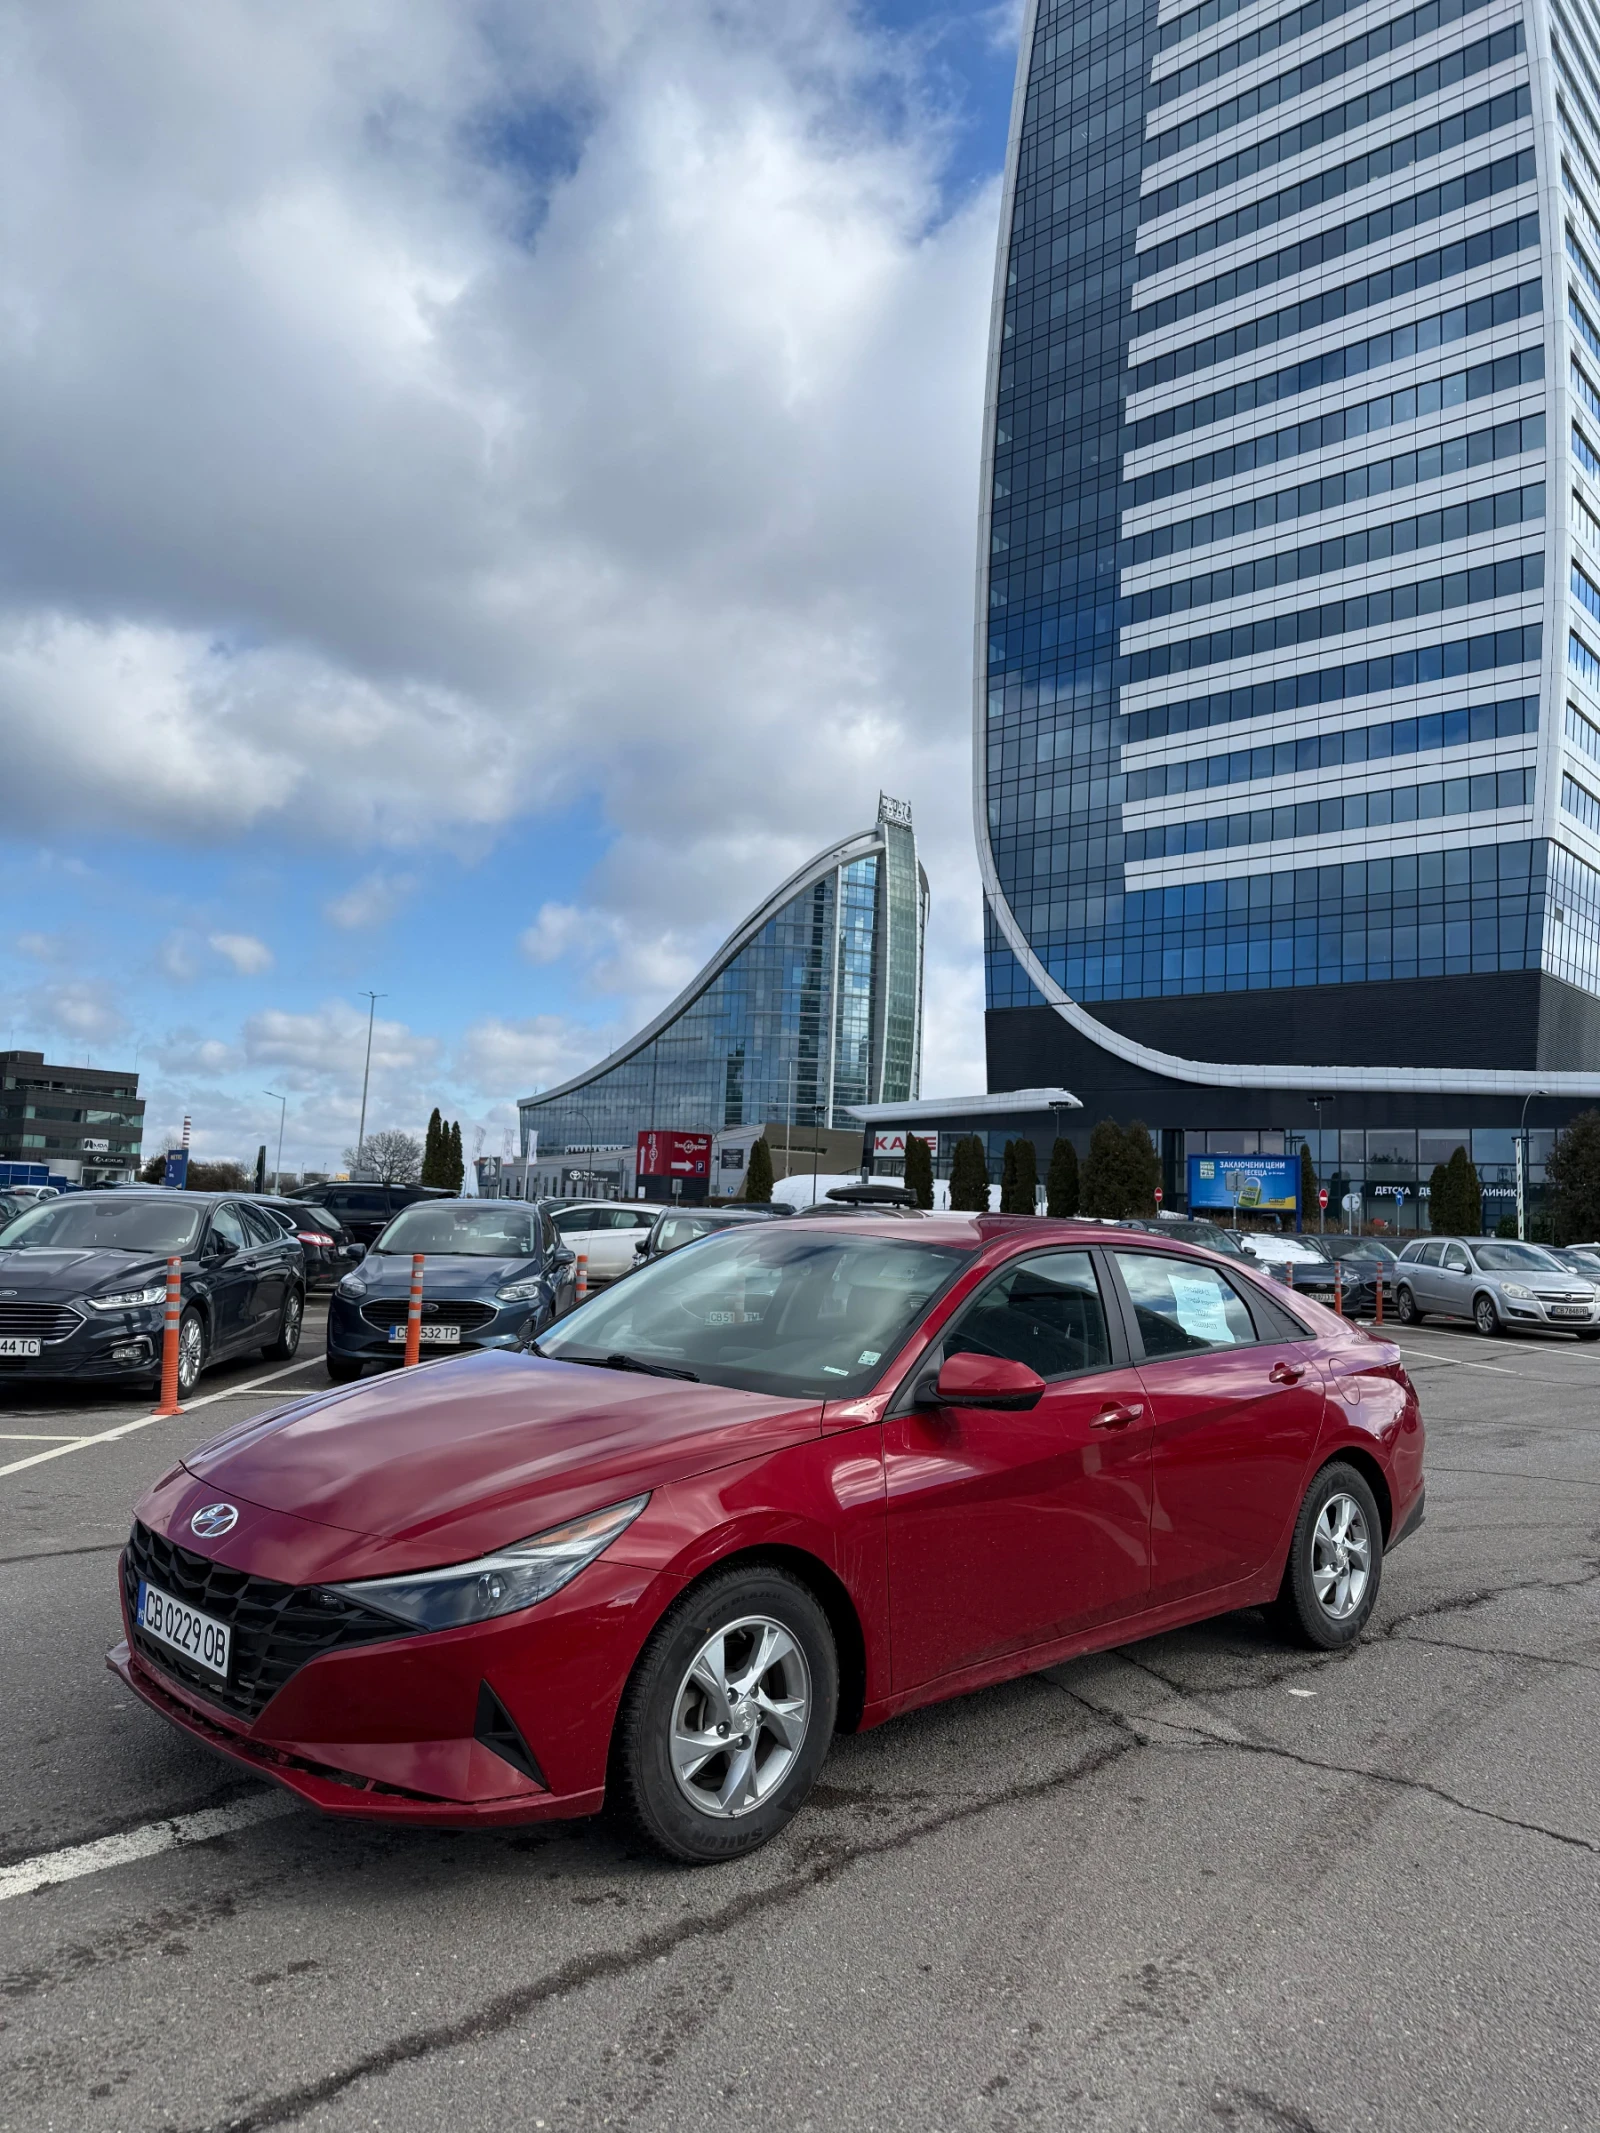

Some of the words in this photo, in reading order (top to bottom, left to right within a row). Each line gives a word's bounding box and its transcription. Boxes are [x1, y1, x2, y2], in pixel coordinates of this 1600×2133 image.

[875, 1136, 937, 1150] KAE
[1219, 1161, 1264, 1169] ЗАКЛЮЧЕНИ
[1265, 1161, 1286, 1170] ЦЕНИ
[1375, 1186, 1411, 1196] ДЕТСКА
[444, 1327, 458, 1339] TP
[19, 1340, 37, 1354] TC
[145, 1590, 163, 1632] CB
[165, 1602, 201, 1654] 0229
